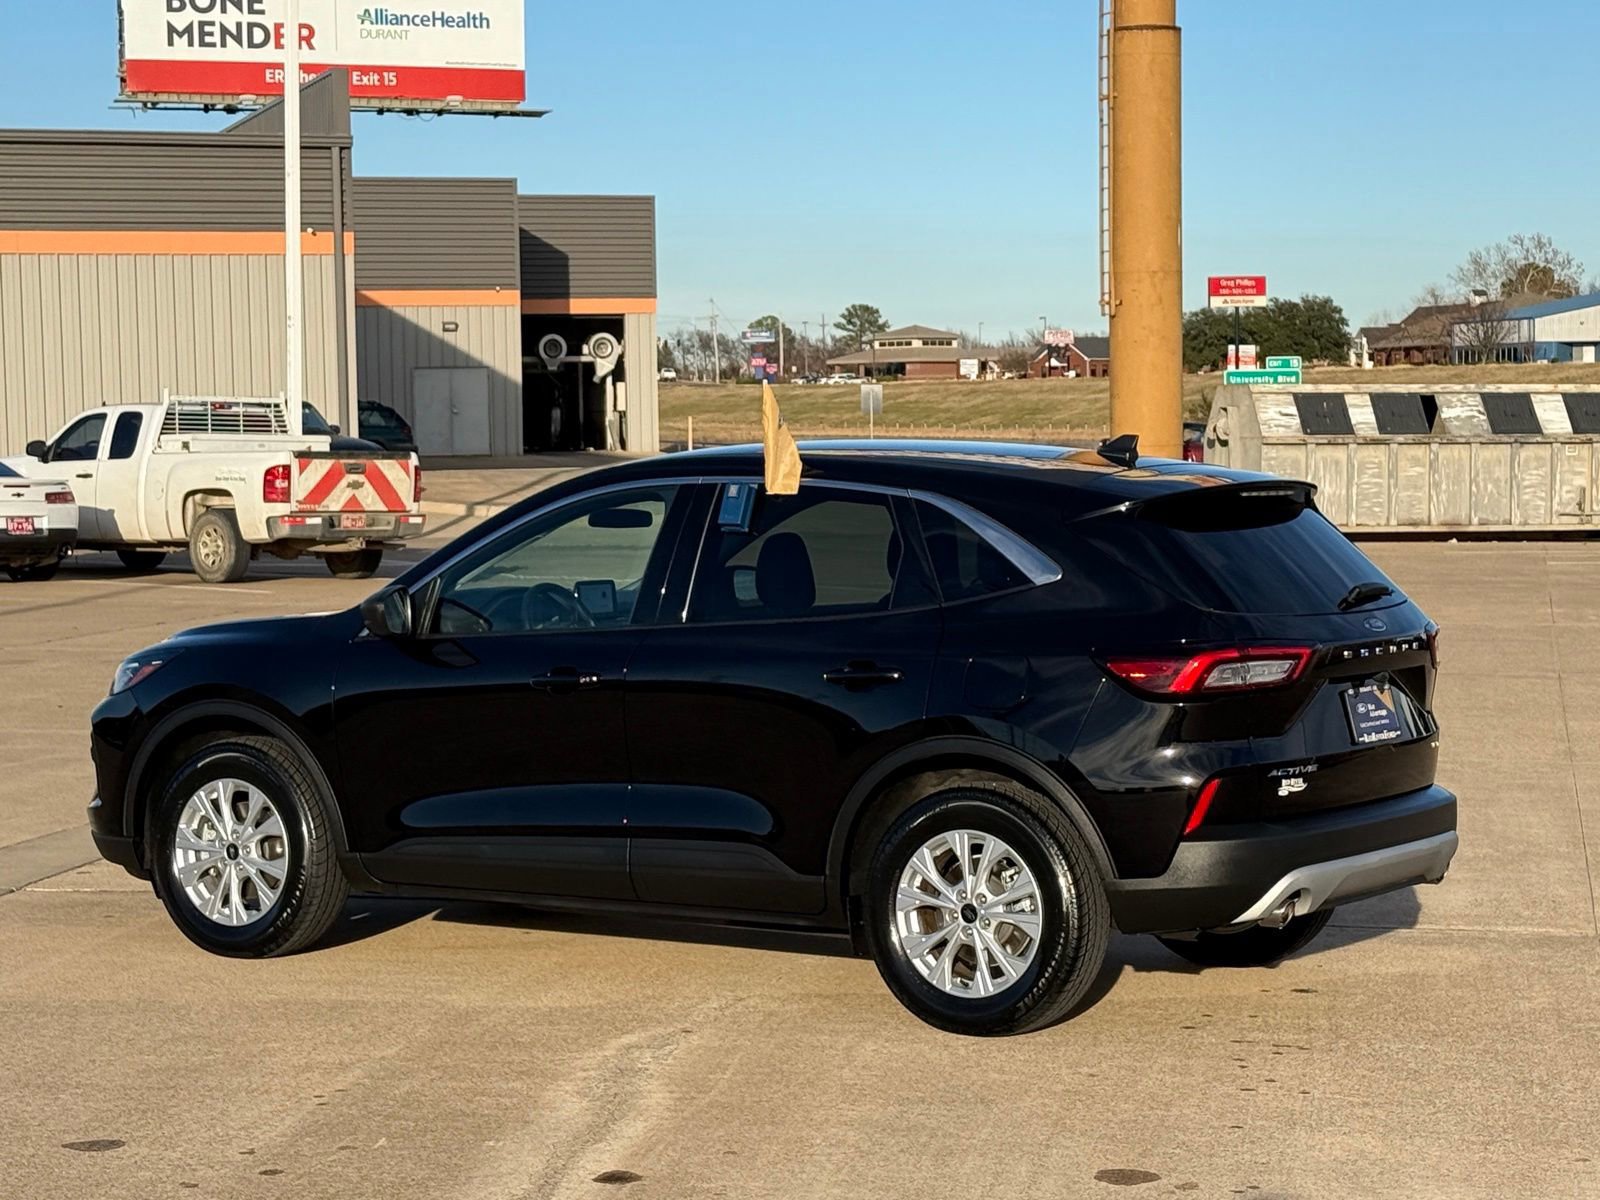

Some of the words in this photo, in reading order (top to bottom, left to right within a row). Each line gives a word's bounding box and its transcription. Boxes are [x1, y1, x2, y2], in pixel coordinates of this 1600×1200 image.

[357, 8, 490, 29] AllianceHealth
[359, 28, 410, 41] DURANT
[352, 72, 380, 86] Exit
[383, 72, 397, 86] 15
[1290, 359, 1299, 367] 15
[1230, 375, 1274, 384] University
